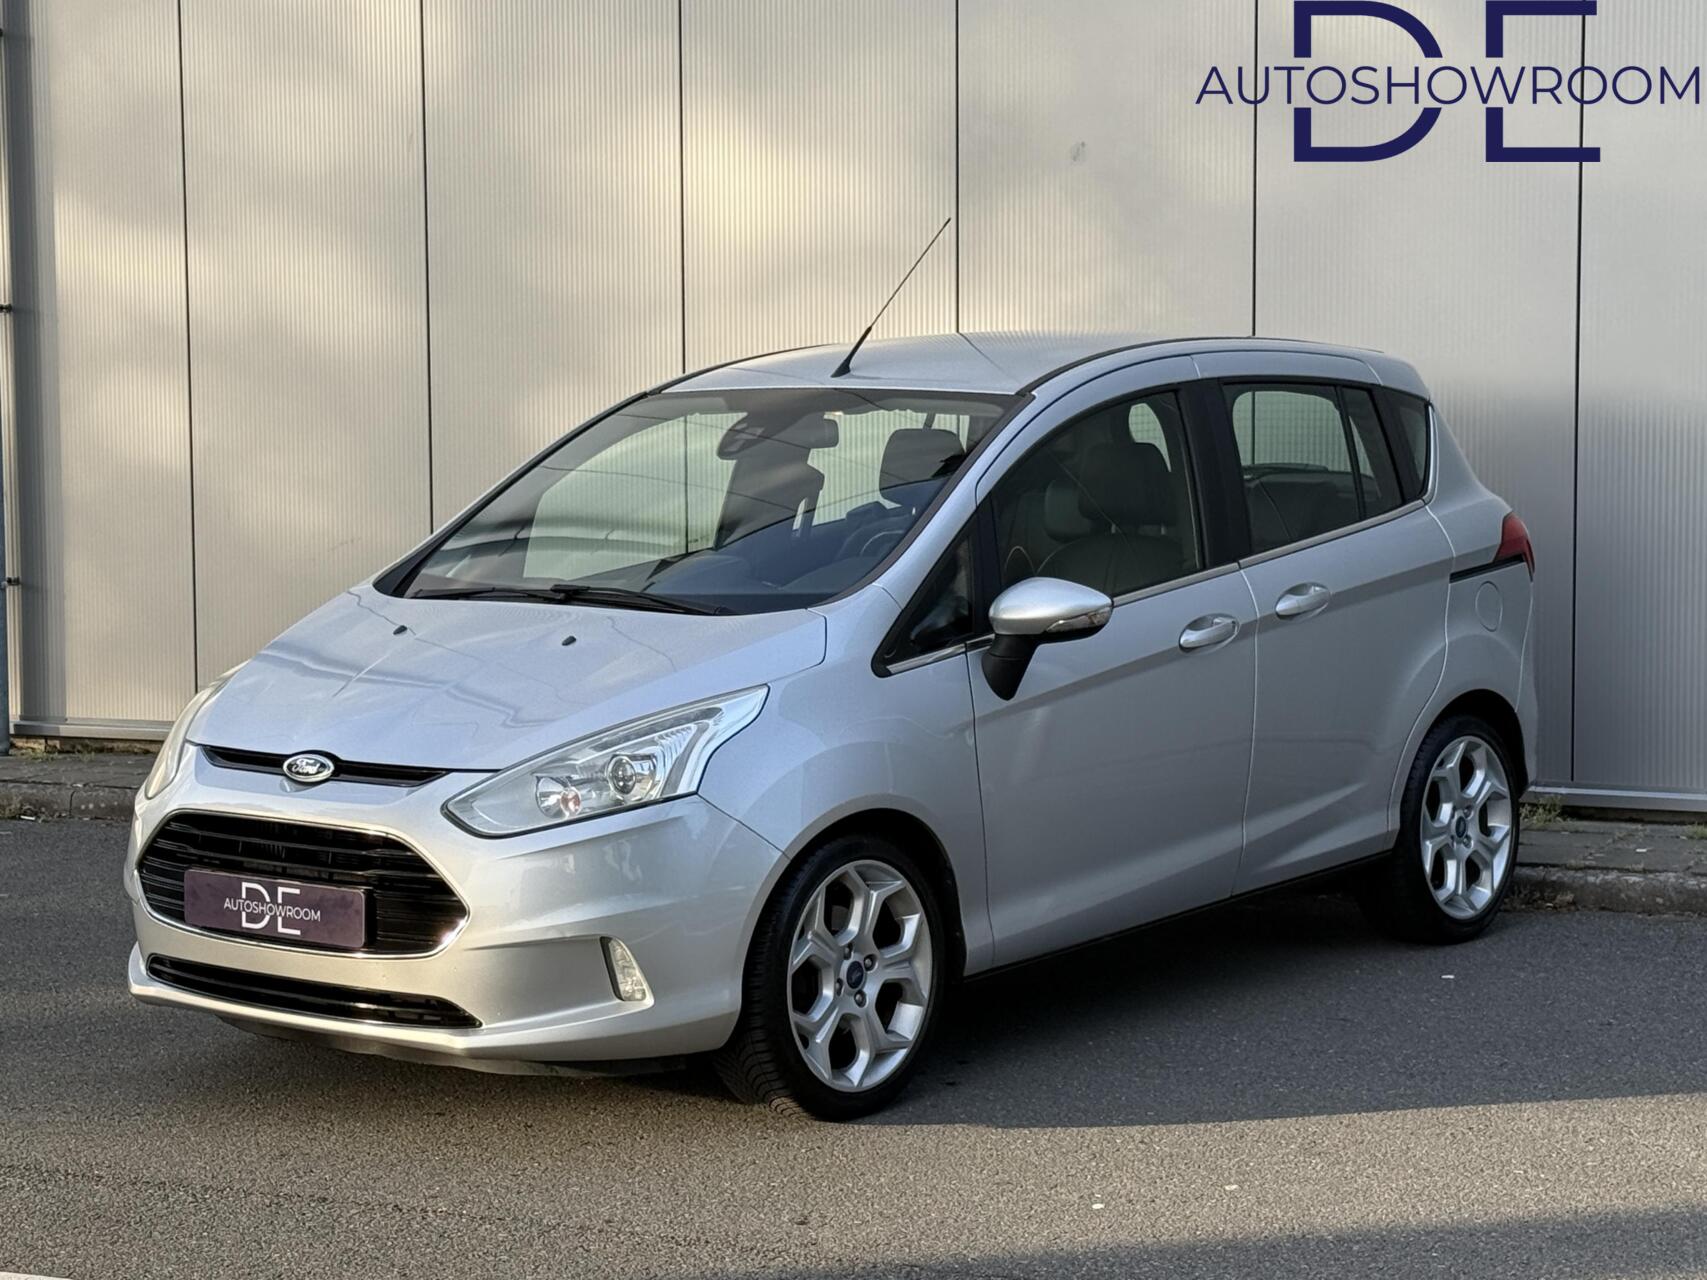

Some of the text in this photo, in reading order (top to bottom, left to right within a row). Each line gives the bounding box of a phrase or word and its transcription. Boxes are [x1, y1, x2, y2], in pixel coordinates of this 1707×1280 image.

[292, 758, 321, 774] Ford
[224, 898, 321, 922] AUTOSHOWROOM
[241, 882, 301, 936] DE
